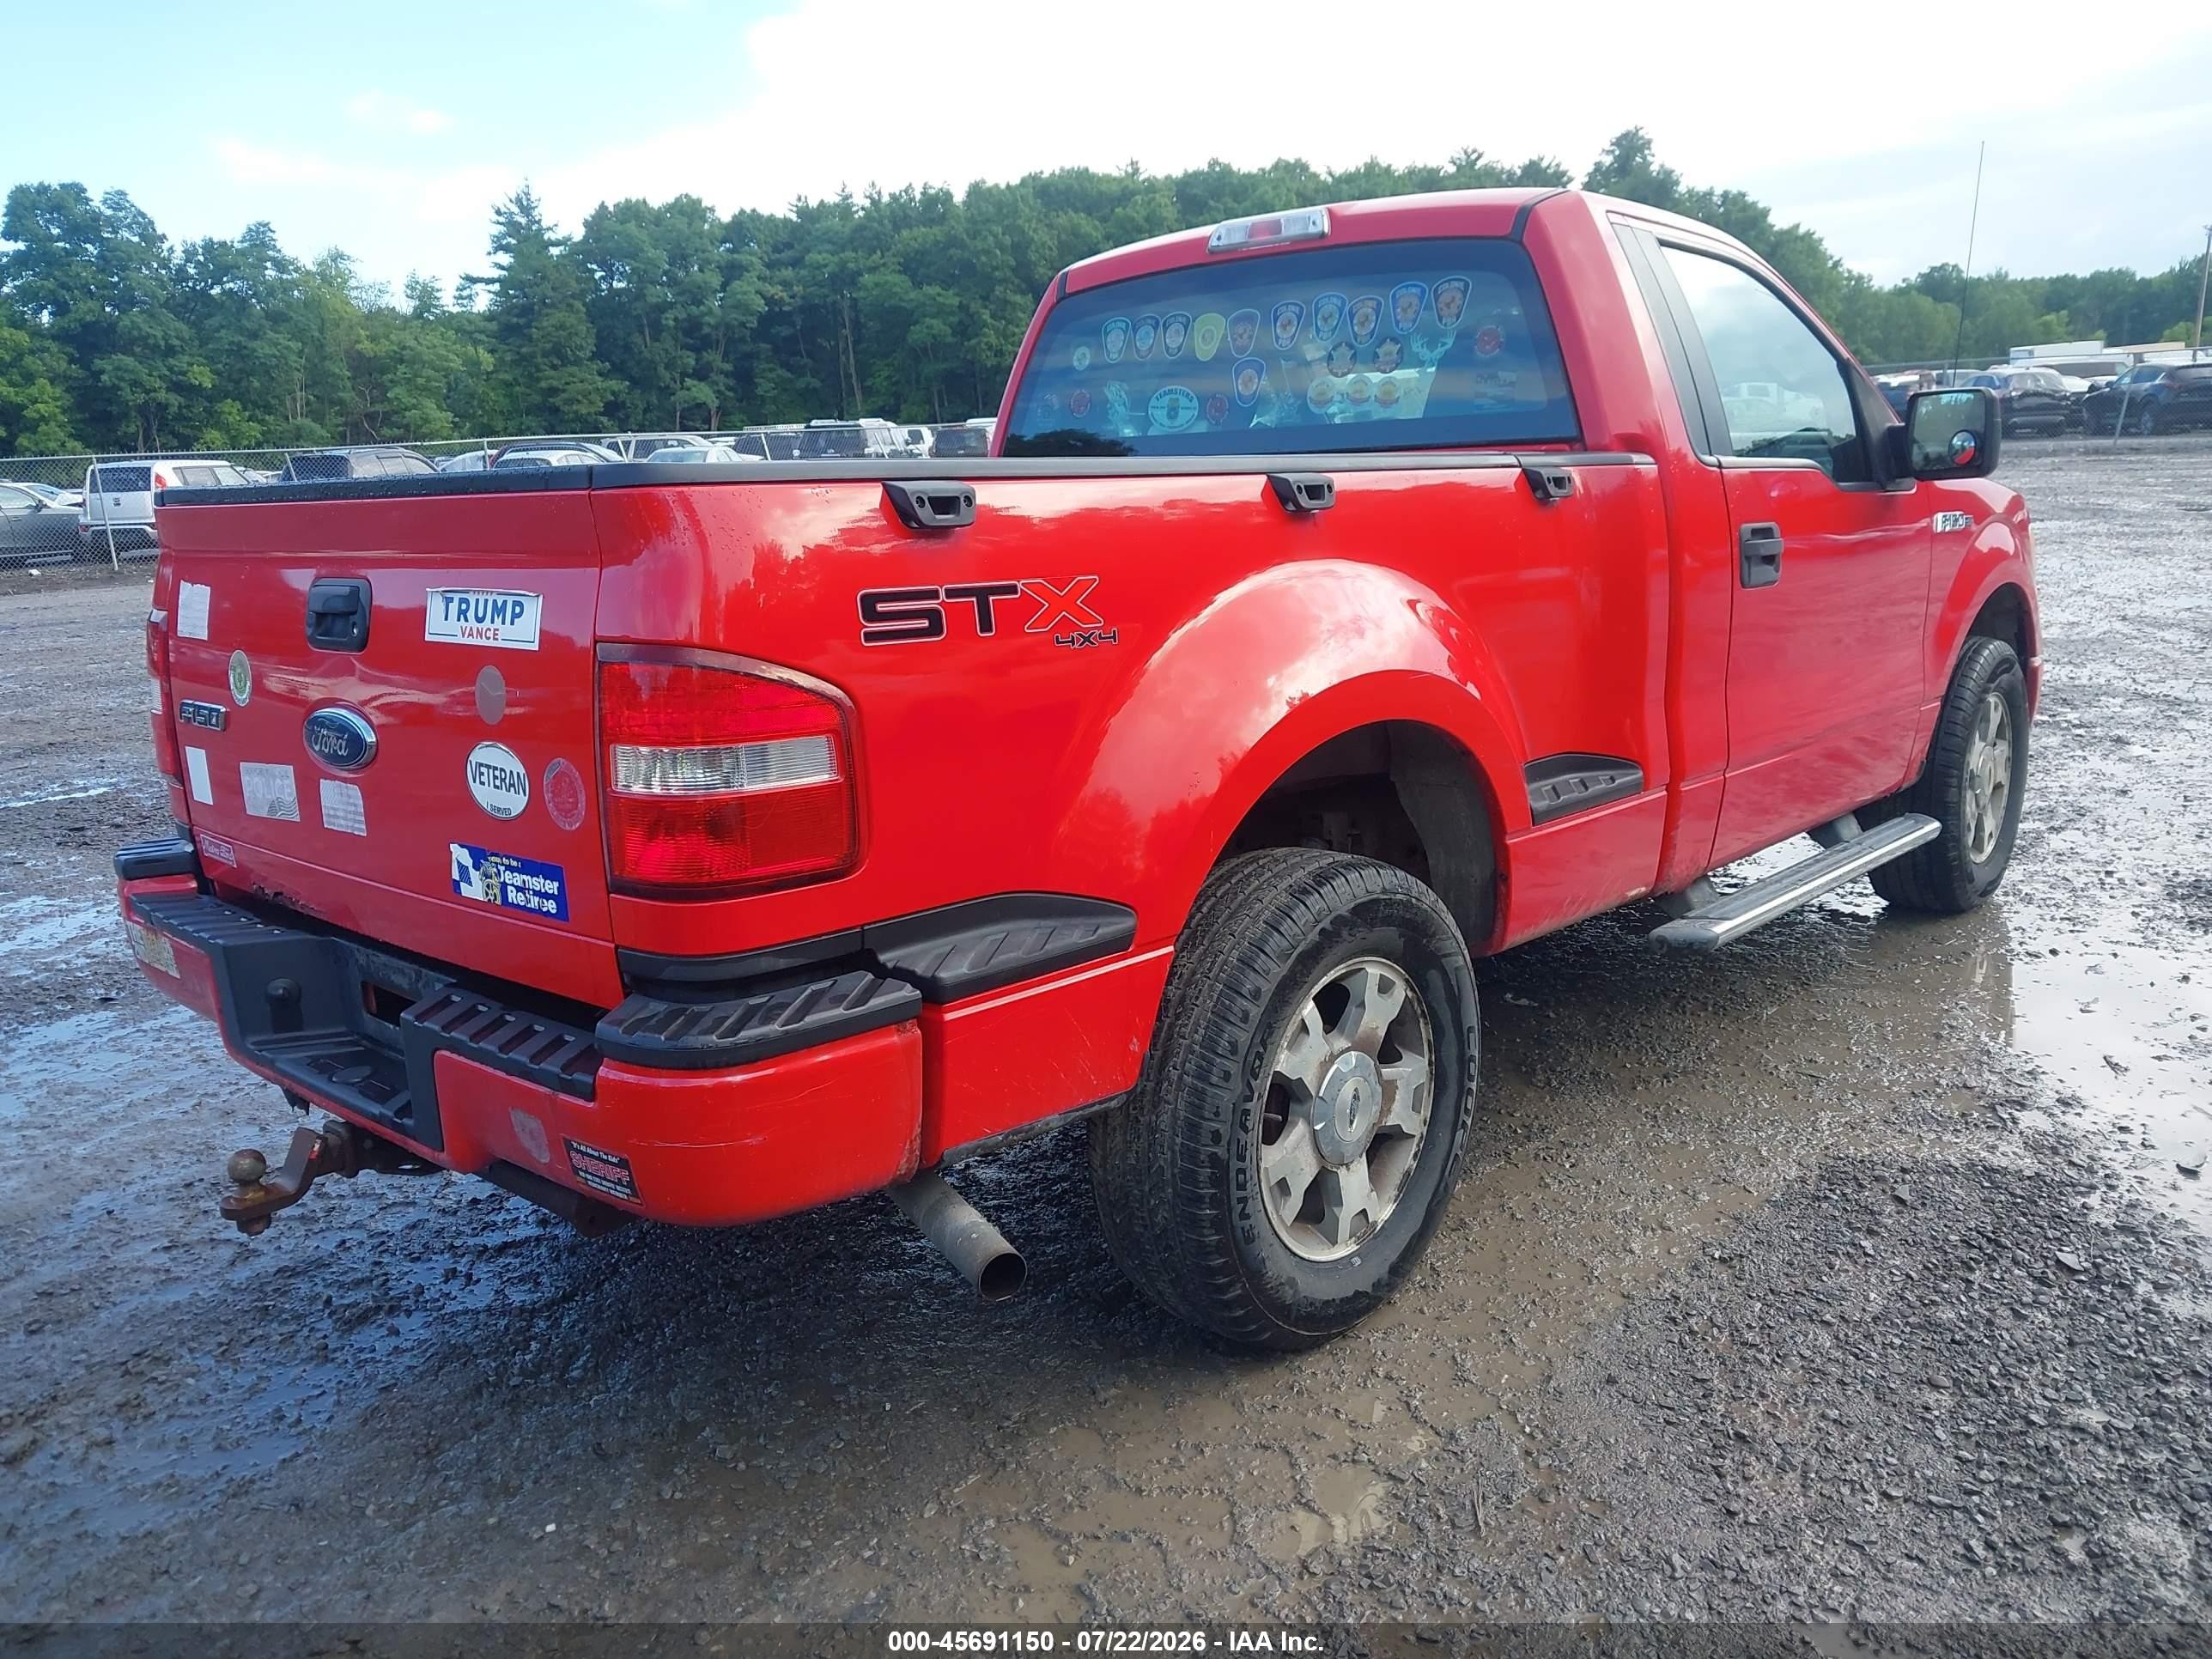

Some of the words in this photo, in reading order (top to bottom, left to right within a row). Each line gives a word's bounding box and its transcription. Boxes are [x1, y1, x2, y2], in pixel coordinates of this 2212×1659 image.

[1154, 387, 1195, 404] TEAMSTERS
[442, 596, 525, 626] TRUMP
[857, 576, 1104, 646] STX
[460, 624, 500, 641] VANCE
[312, 726, 349, 757] Ford
[469, 759, 527, 798] VETERAN
[489, 803, 512, 817] SERVED
[498, 865, 560, 896] Teamster
[507, 885, 558, 915] Retiree
[570, 1151, 630, 1186] SHERIFF
